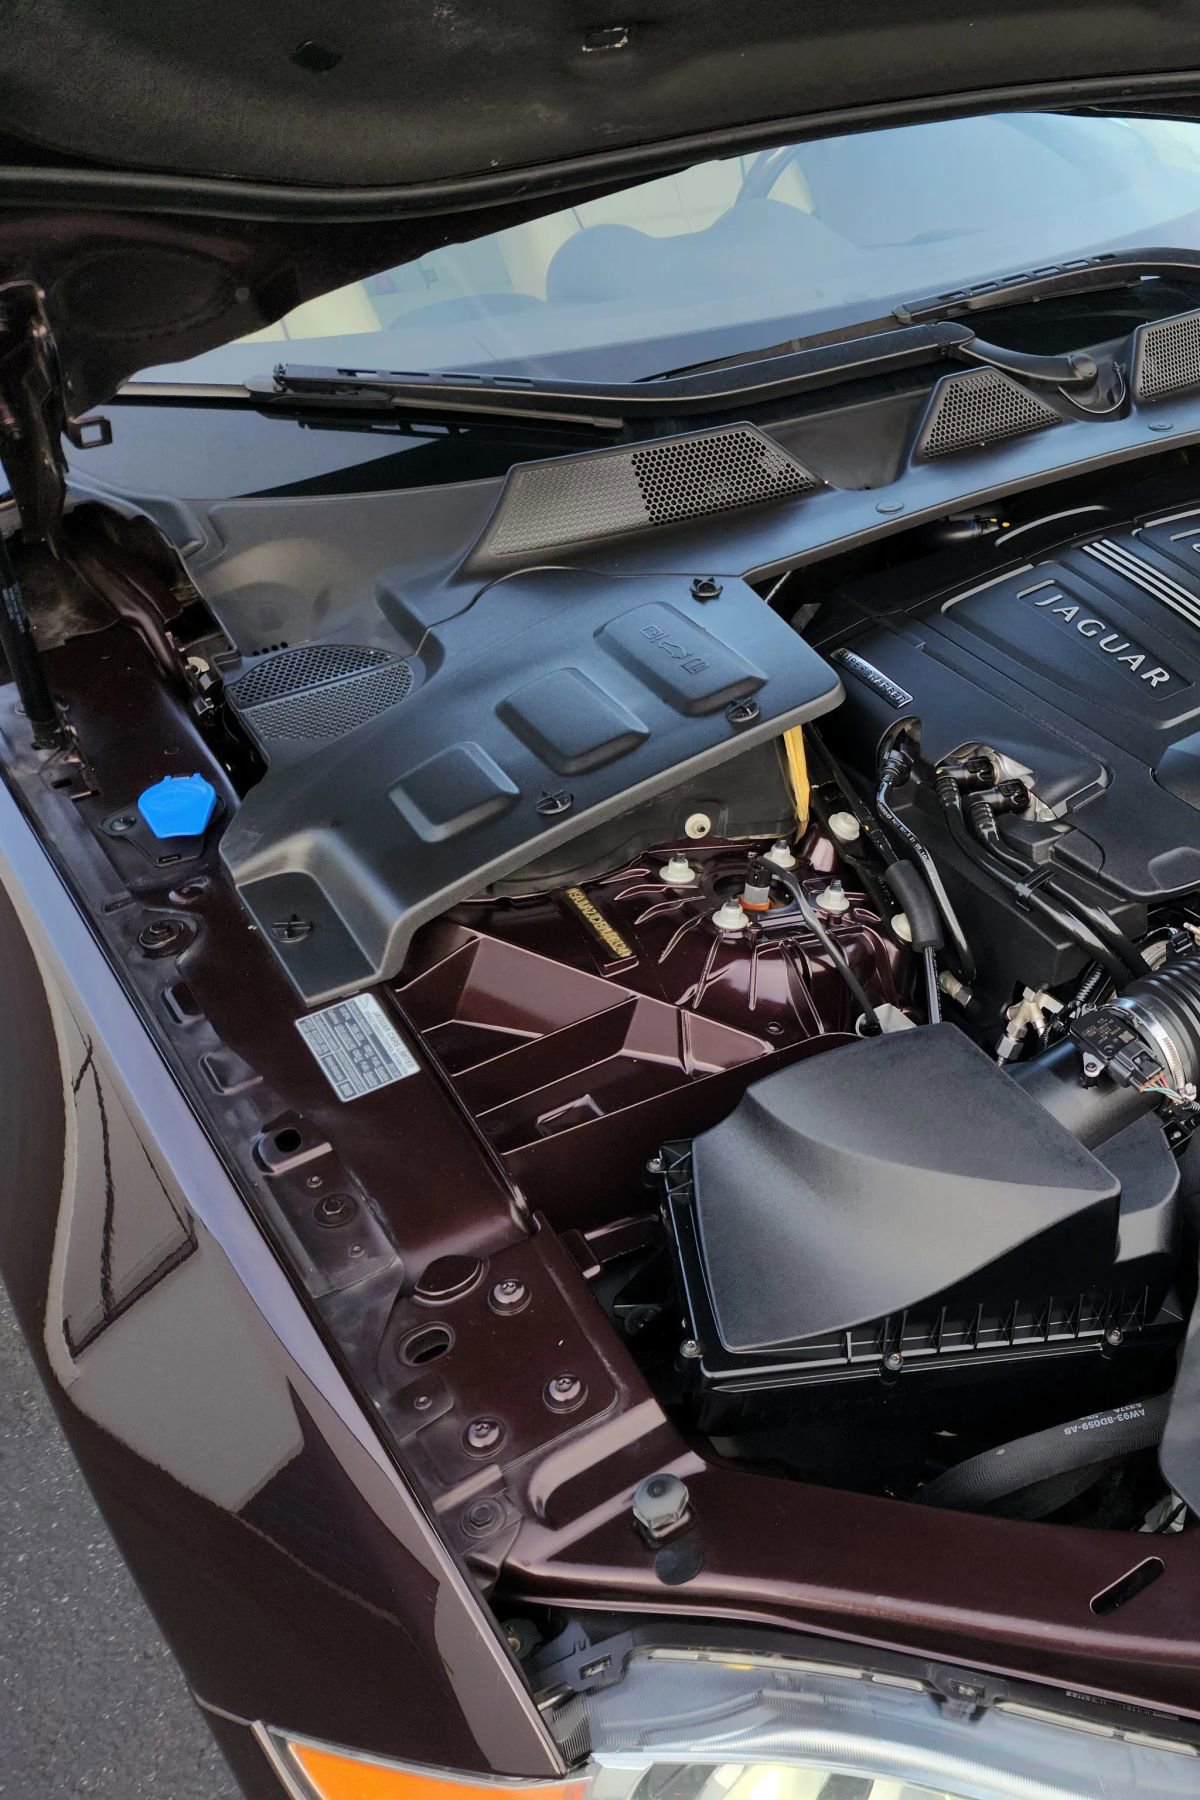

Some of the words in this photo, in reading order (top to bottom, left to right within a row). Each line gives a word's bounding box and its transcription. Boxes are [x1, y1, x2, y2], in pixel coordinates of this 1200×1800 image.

[1034, 594, 1171, 690] JAGUAR
[374, 1011, 392, 1032] JAGUAR
[386, 1030, 402, 1048] CARS
[396, 1046, 414, 1069] LIMITED
